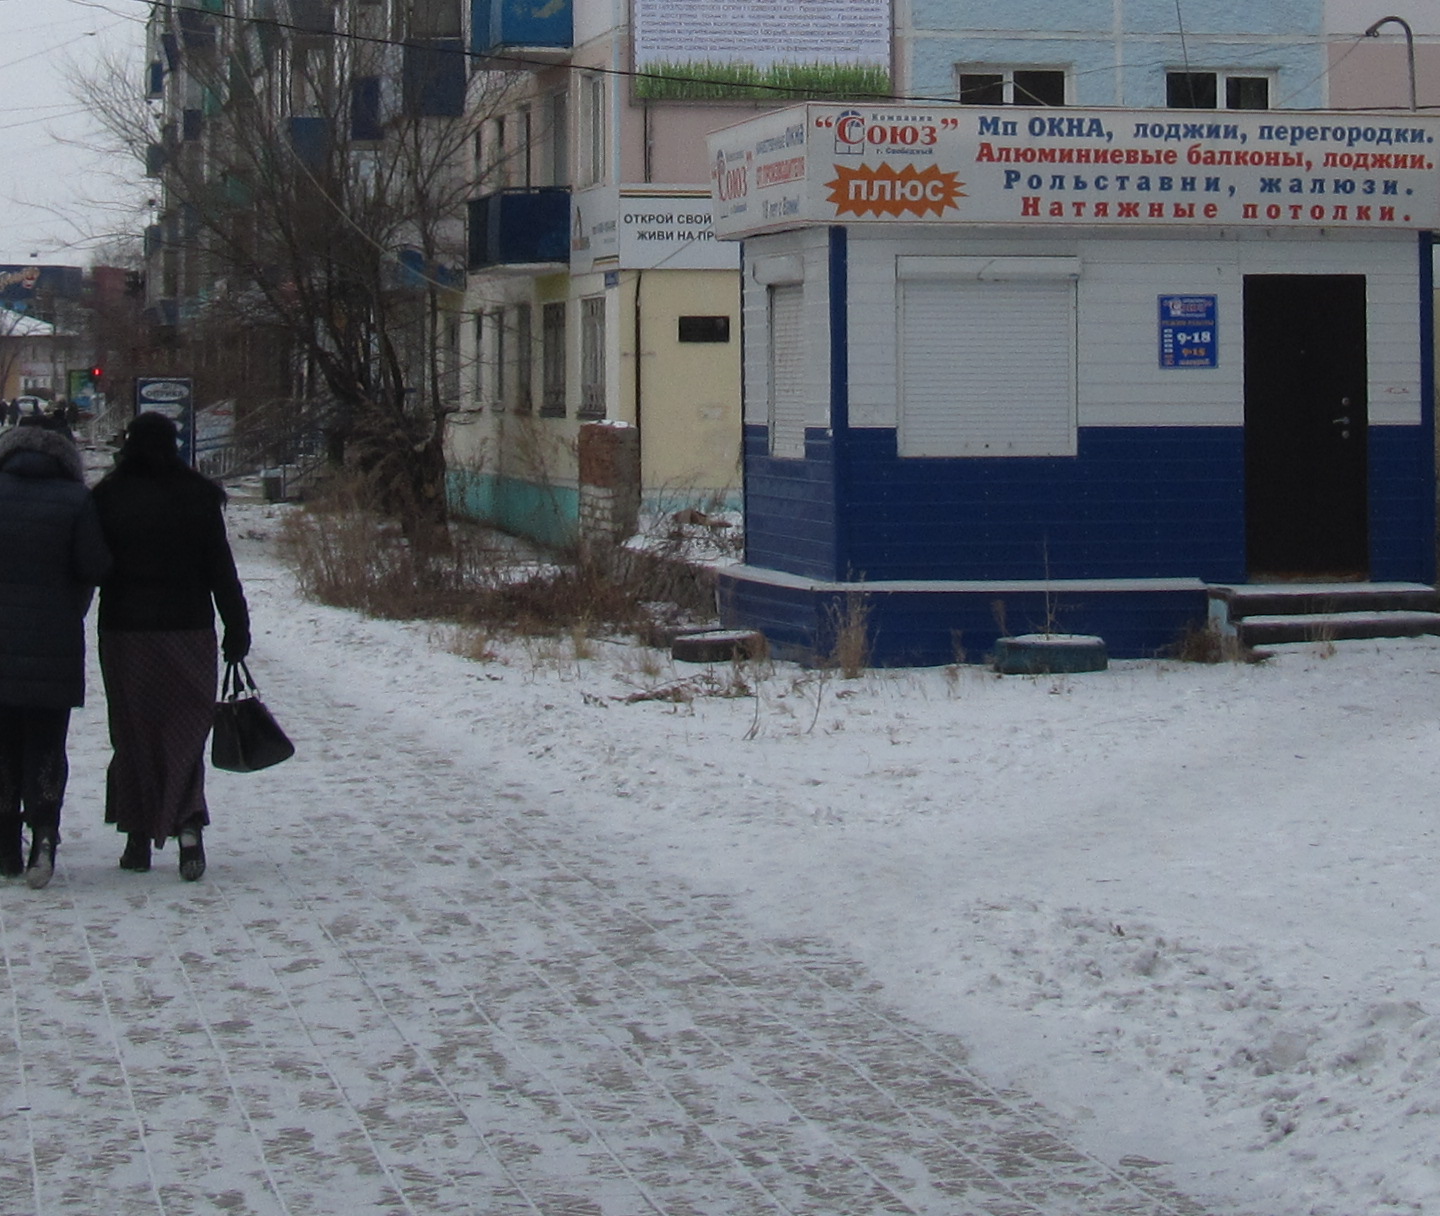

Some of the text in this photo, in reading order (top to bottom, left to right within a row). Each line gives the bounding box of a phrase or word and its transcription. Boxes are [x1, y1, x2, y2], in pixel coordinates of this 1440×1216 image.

[1028, 117, 1113, 142] ОКНА,
[1133, 122, 1247, 145] лоджии,
[1259, 124, 1434, 146] перегородки.
[975, 142, 1434, 172] Алюминиевые балконы, лоджии.
[848, 179, 944, 201] ПЛЮС
[1003, 170, 1413, 197] Рольставни, жалюзи.
[623, 212, 711, 224] ОТКРОЙ СВОЙ
[1021, 196, 1411, 222] Натяжные потолки.
[637, 230, 715, 241] ЖИВИ НА ПР
[1176, 331, 1211, 345] 9-18
